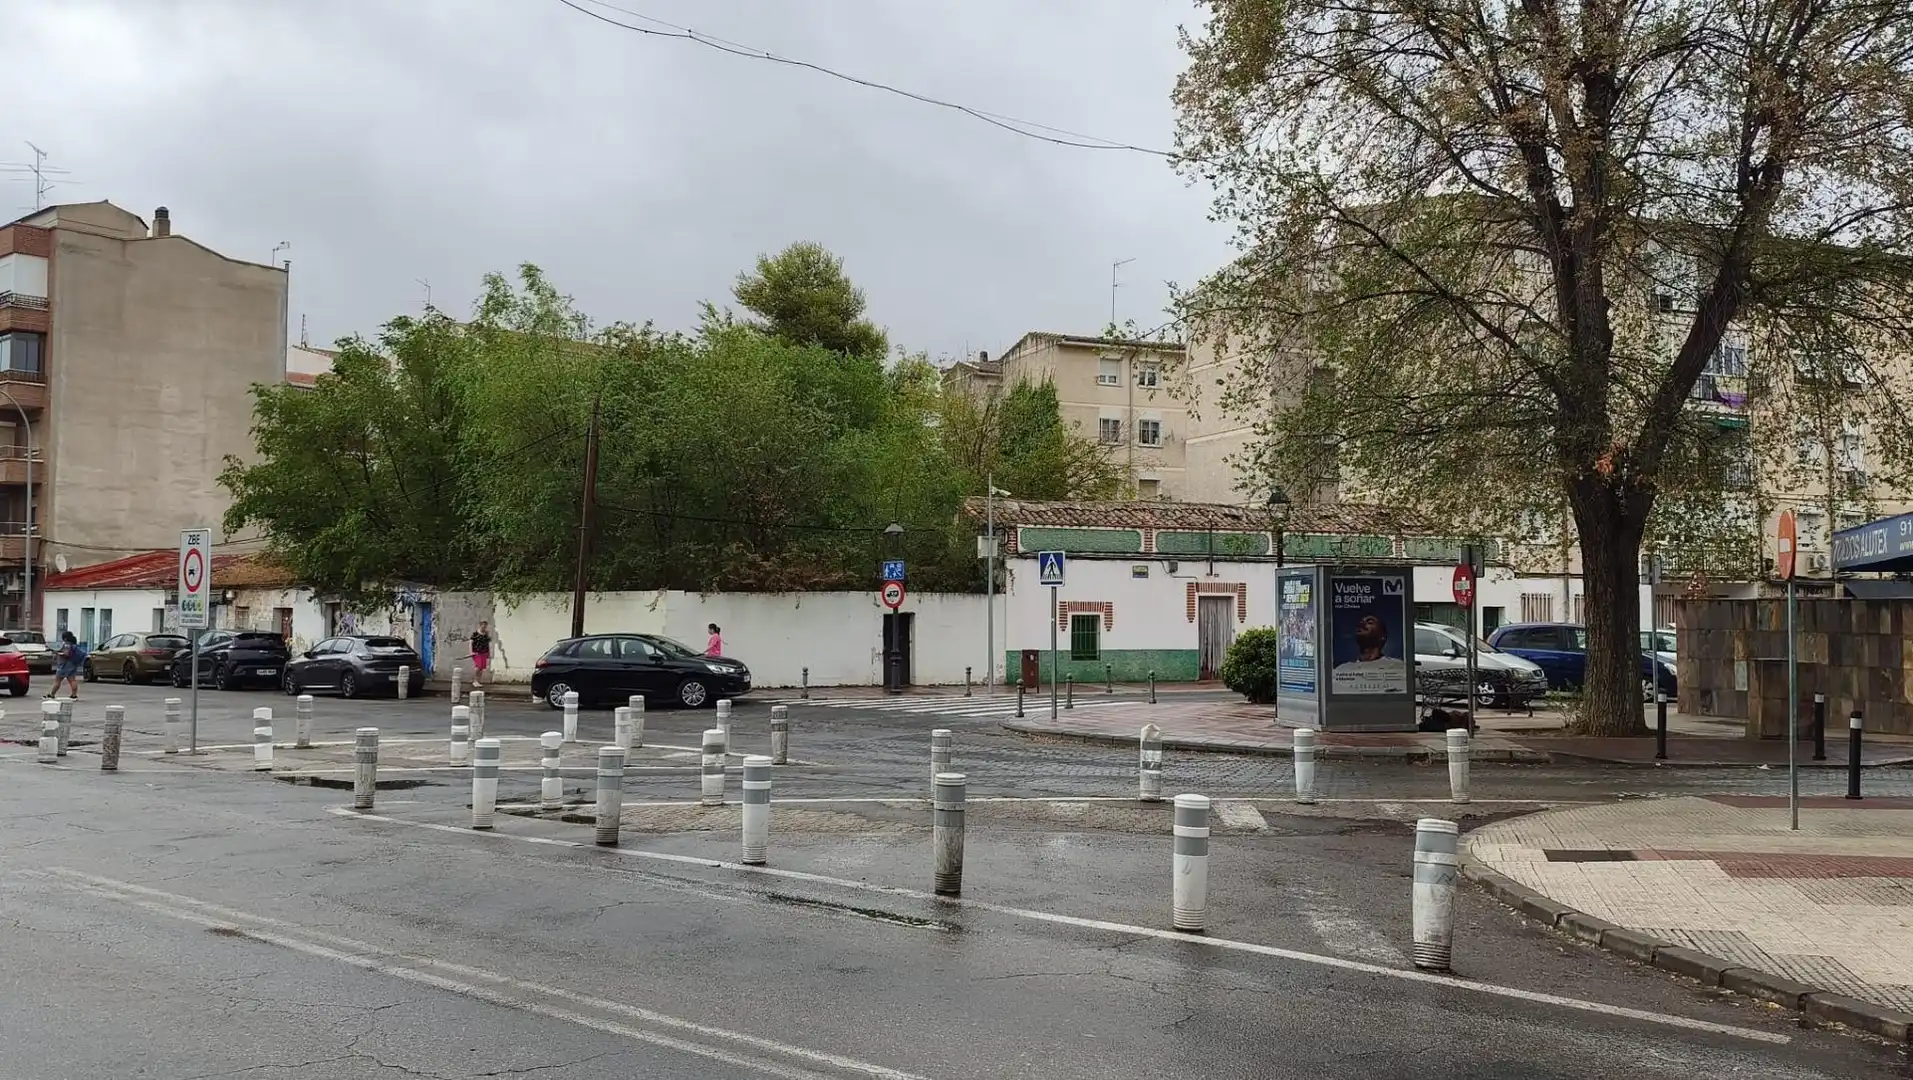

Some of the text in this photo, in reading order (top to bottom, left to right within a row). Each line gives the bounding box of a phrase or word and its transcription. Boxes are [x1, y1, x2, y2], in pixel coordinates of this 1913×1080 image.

[187, 534, 200, 545] ZBE
[1860, 527, 1888, 558] ALUTEX
[1334, 582, 1371, 594] Vuelve
[1334, 595, 1342, 604] a
